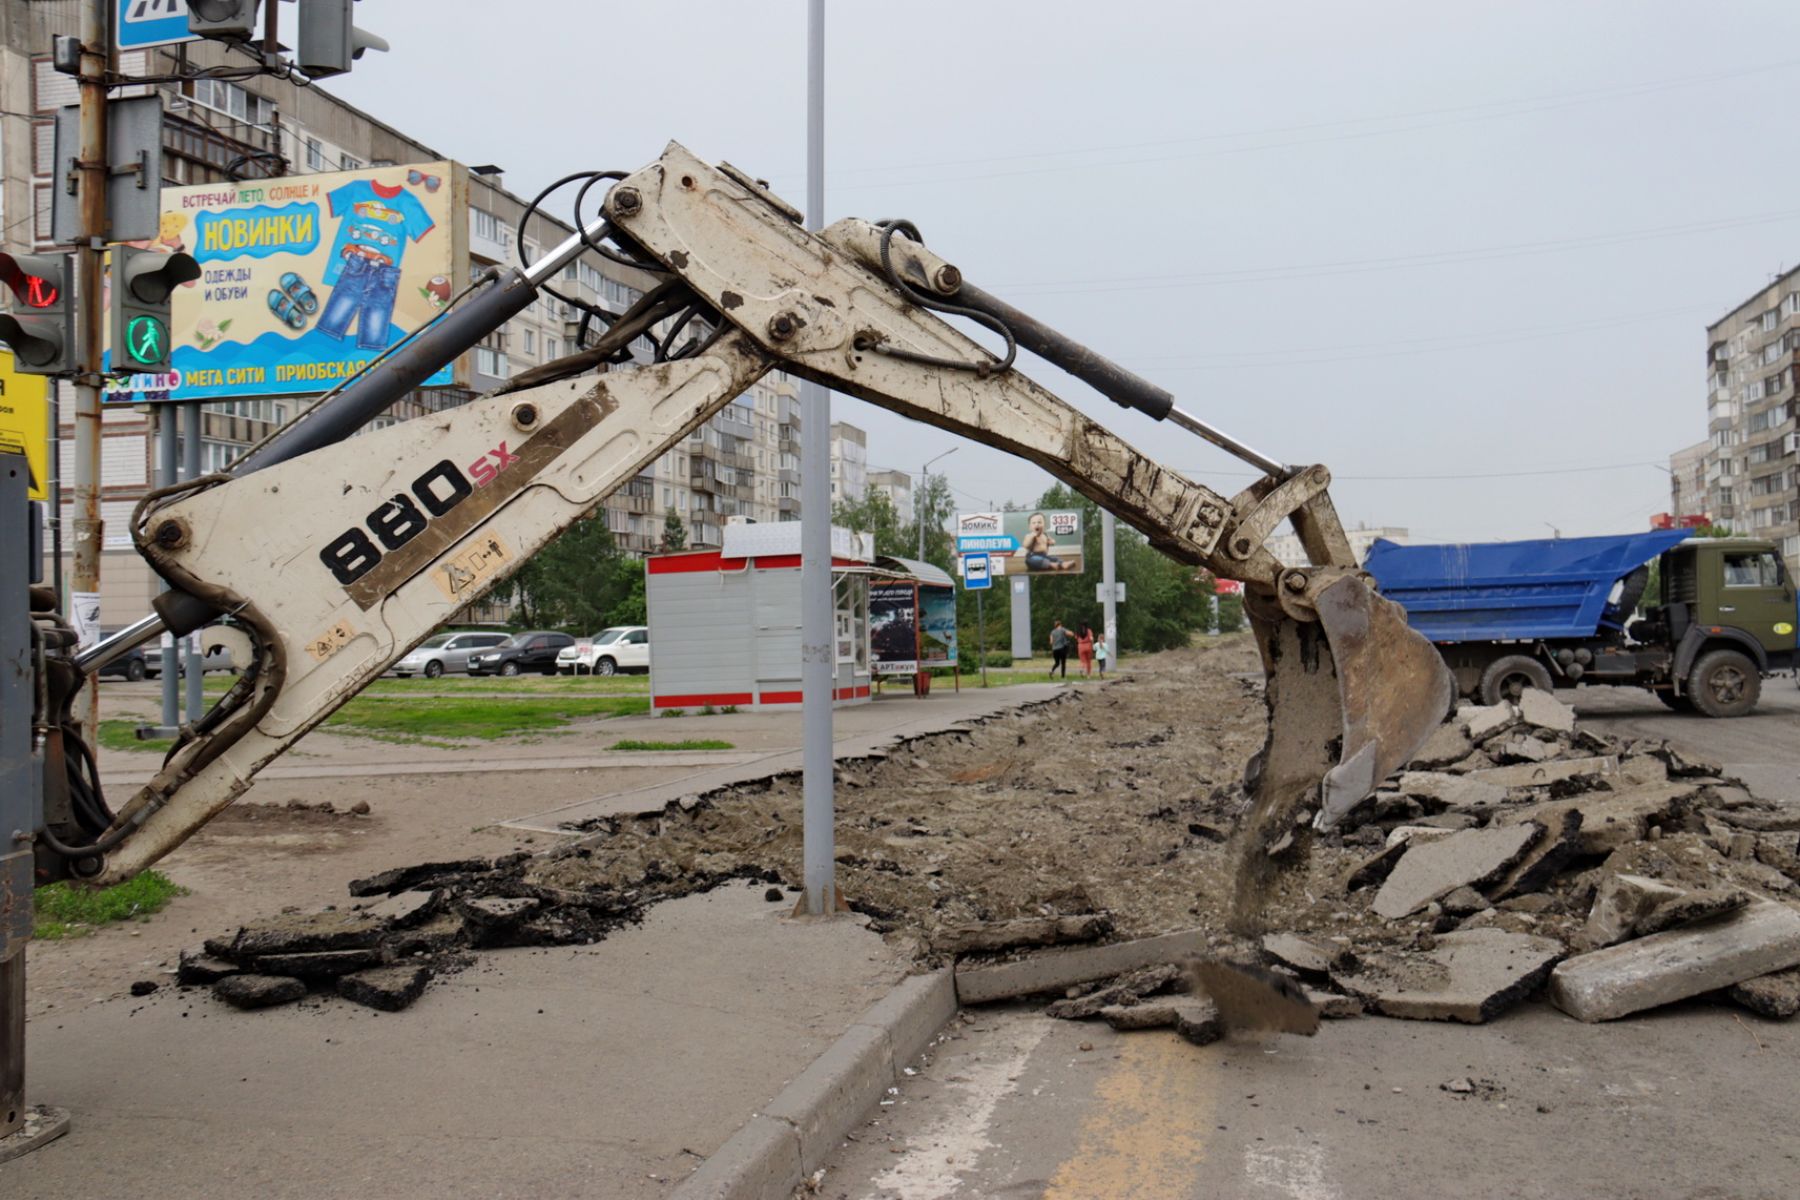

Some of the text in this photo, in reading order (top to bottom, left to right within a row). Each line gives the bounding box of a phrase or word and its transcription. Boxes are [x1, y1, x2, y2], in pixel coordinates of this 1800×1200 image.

[182, 189, 236, 208] ВСТРЕЧАЙ
[269, 185, 308, 201] СОЛНЦЕ
[312, 184, 319, 196] И
[204, 213, 312, 252] НОВИНКИ
[204, 267, 251, 284] ОДЕЖДЫ
[204, 286, 248, 302] И ОБУВИ
[186, 369, 224, 387] МЕГА
[227, 367, 265, 385] СИТИ
[319, 440, 521, 586] 880 SX
[1052, 515, 1069, 526] 333
[961, 521, 998, 531] ДОМИКС
[960, 538, 1012, 550] ЛИНОЛЕУМ
